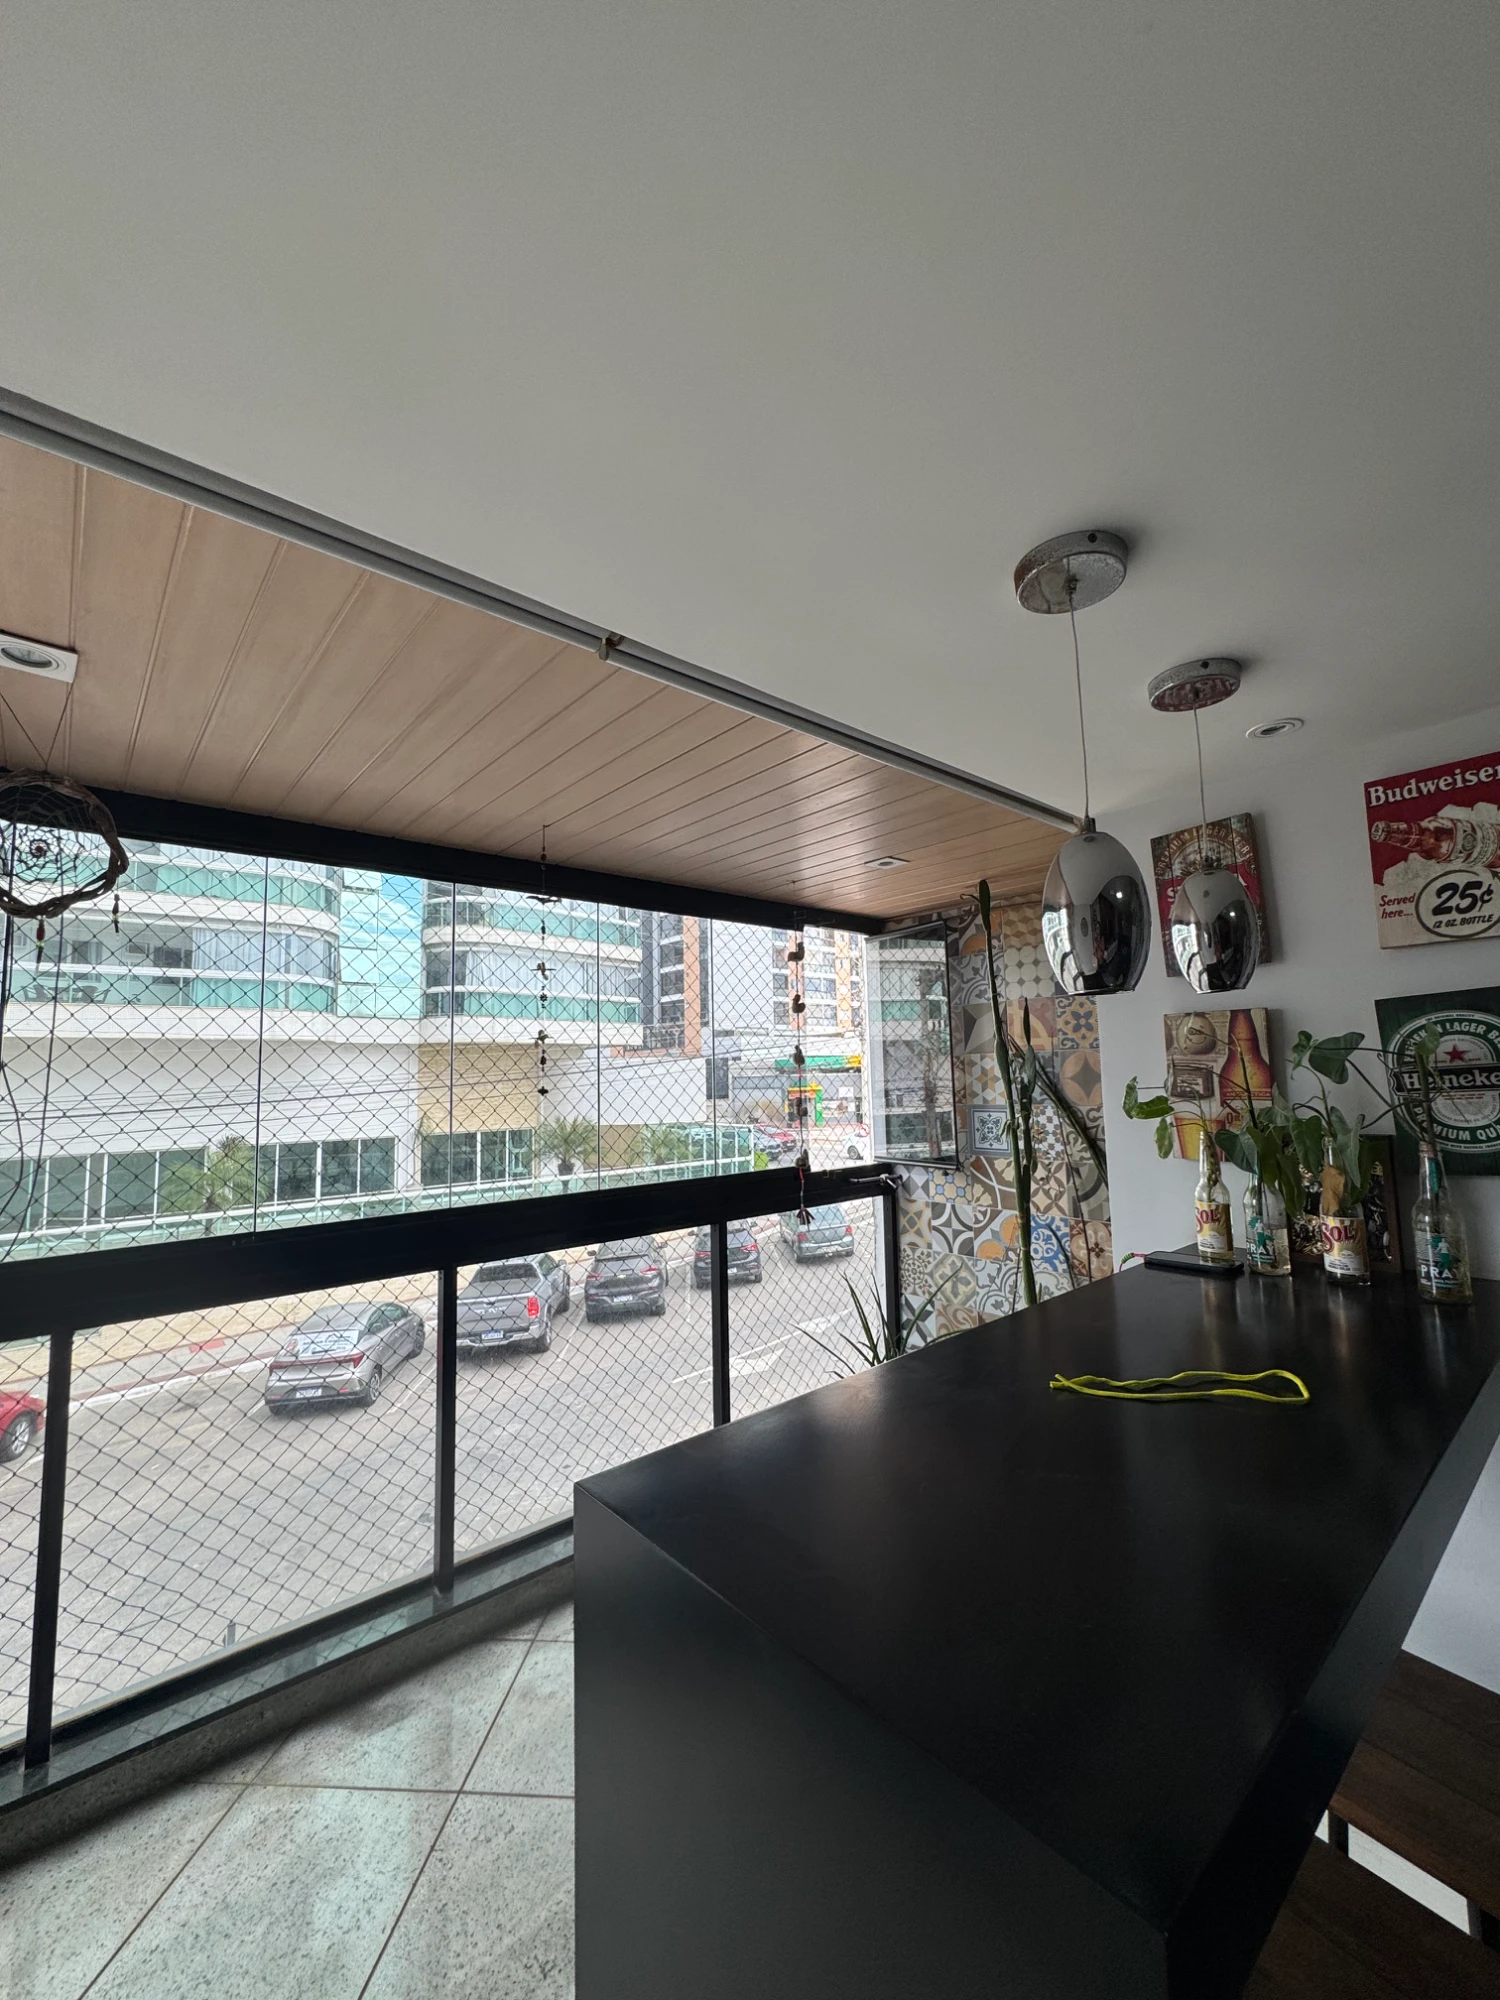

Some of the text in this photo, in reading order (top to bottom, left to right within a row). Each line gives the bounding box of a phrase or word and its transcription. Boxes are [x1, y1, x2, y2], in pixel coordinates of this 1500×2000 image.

[1227, 833, 1250, 854] BEER
[1379, 892, 1416, 907] Served
[1433, 920, 1443, 928] 12
[1459, 914, 1494, 926] BOTTLE
[1445, 1021, 1487, 1035] LAGER
[1195, 1206, 1220, 1233] SOL
[1321, 1222, 1355, 1253] SOL
